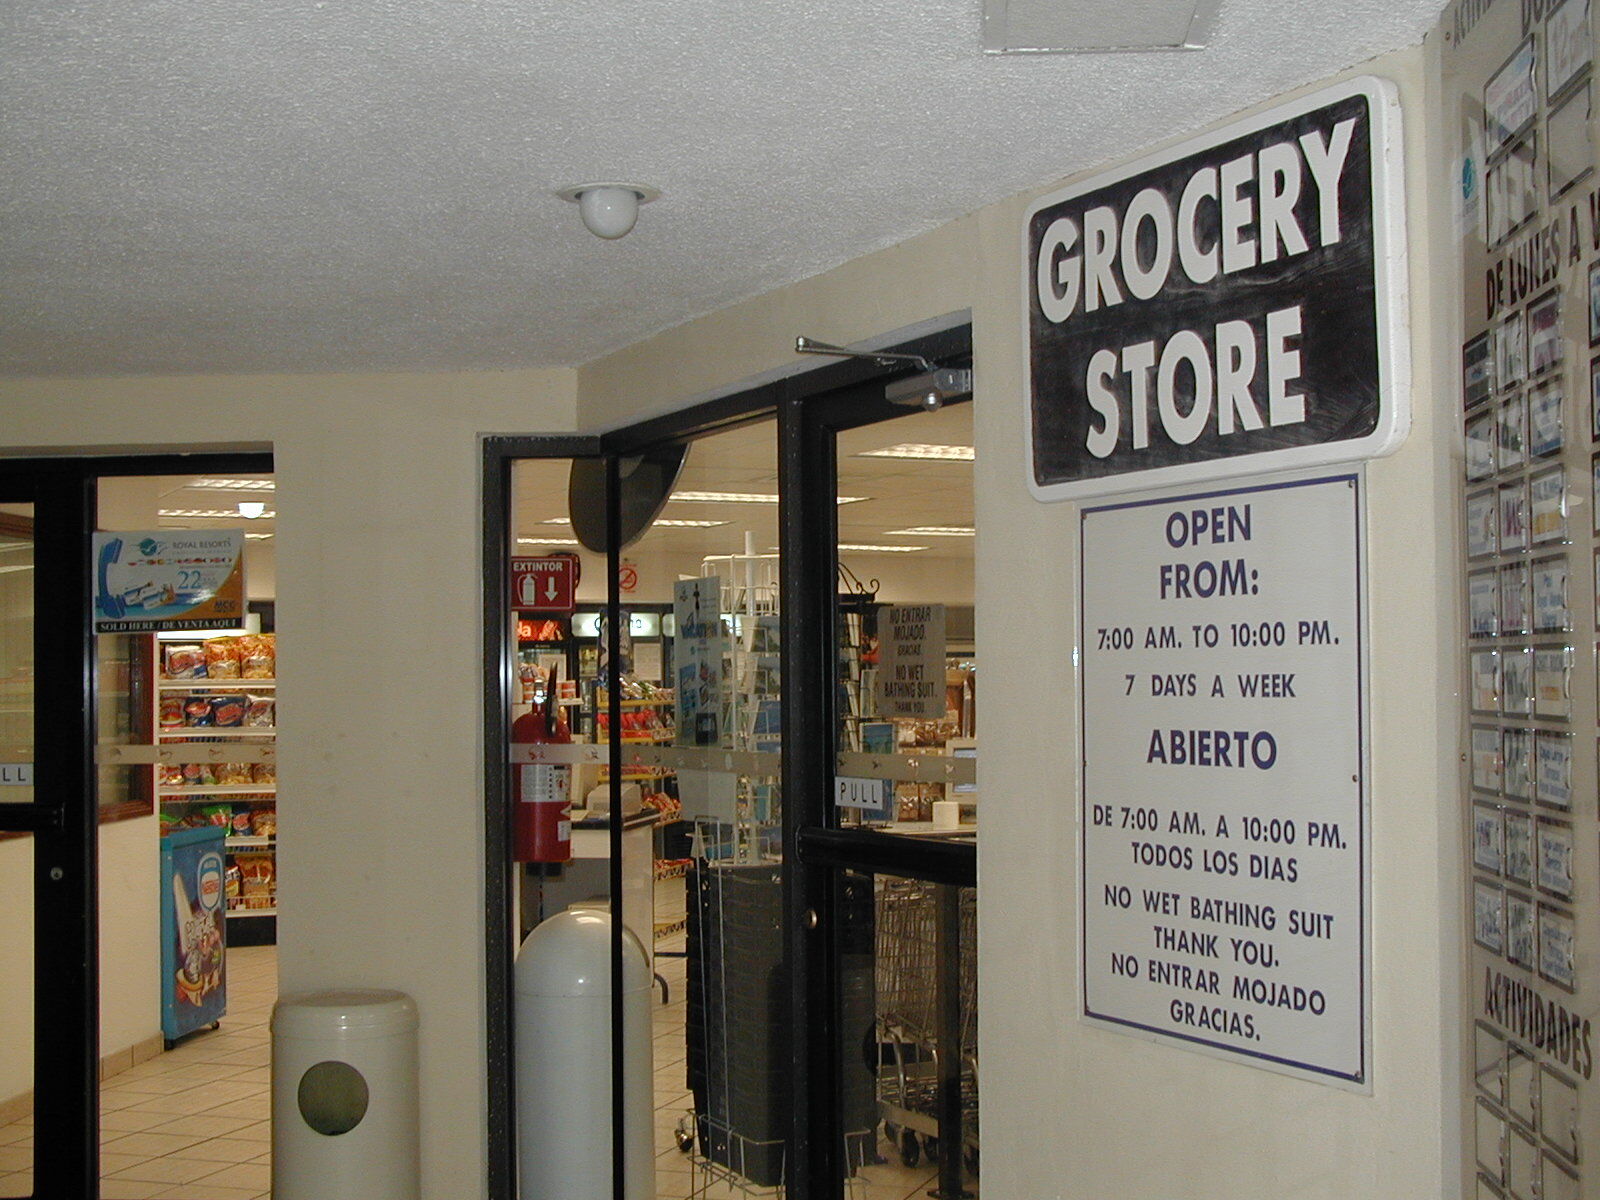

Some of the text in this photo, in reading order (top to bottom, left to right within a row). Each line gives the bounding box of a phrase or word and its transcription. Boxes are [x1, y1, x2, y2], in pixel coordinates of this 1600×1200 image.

[1037, 118, 1356, 323] GROCERY
[1486, 259, 1504, 321] DE
[1509, 218, 1561, 306] LUNES
[1568, 205, 1581, 268] A
[1086, 305, 1305, 458] STORE
[173, 540, 232, 549] ROYAL RESORTS
[1165, 504, 1251, 548] OPEN
[177, 569, 202, 589] 22
[513, 562, 563, 572] EXTINTOR
[1160, 558, 1259, 599] FROM:
[101, 621, 127, 631] SOLD
[128, 621, 155, 630] HERE
[162, 620, 176, 629] DE
[177, 619, 209, 629] VENTA
[212, 618, 236, 628] AQUI
[890, 606, 932, 624] NO ENTRAR
[1097, 620, 1340, 650] 7:00 AM. TO 10:00 PM.
[884, 682, 915, 698] BATHING
[896, 664, 924, 680] NO WET
[1125, 673, 1296, 698] 7 DAYS A WEEK
[1147, 729, 1277, 770] ABIERTO
[840, 782, 878, 804] PULL
[1093, 804, 1347, 849] DE 7:00 AM. A 10:00 PM.
[1131, 841, 1298, 883] TODOS LOS DIAS
[1104, 884, 1334, 940] NO WET BATHING SUIT
[1153, 925, 1279, 968] THANK YOU.
[1111, 952, 1326, 1016] NO ENTRAR MOJADO
[1170, 999, 1260, 1041] GRACIAS.
[1485, 966, 1592, 1081] ACTIVIDADES
